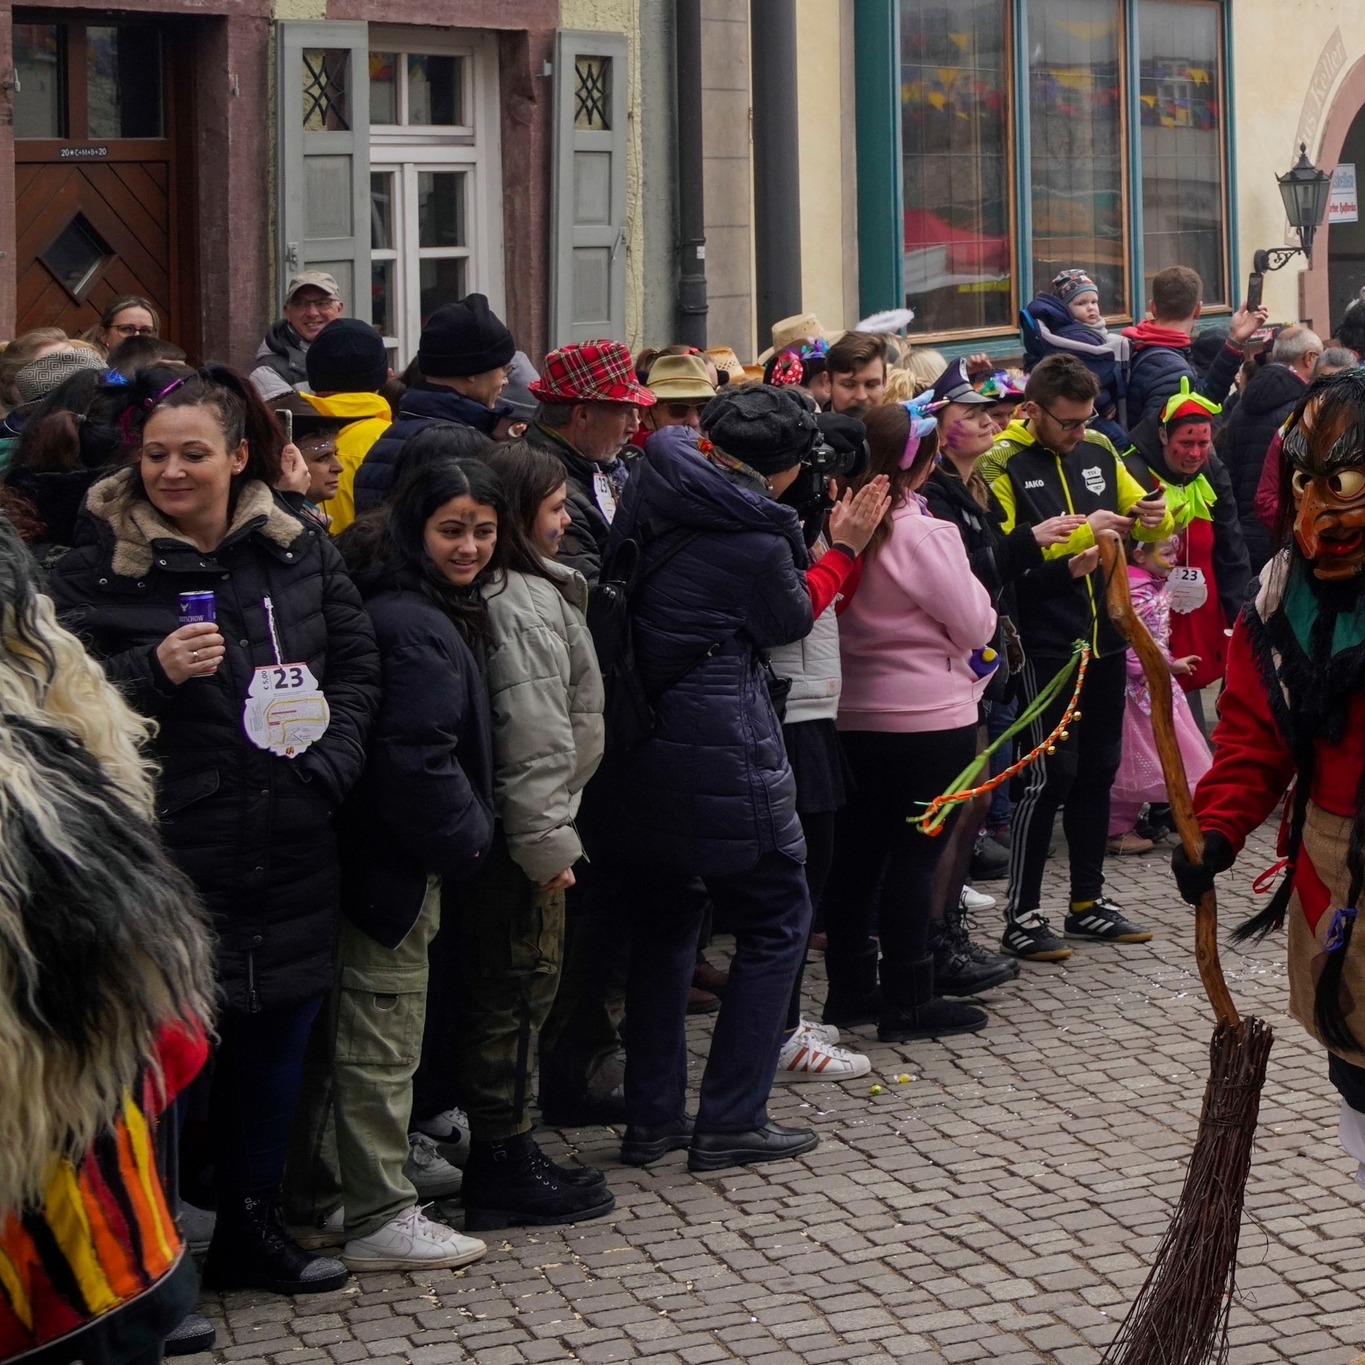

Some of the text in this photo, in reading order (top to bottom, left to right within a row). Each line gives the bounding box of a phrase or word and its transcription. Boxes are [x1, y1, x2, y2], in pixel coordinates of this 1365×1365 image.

[1025, 479, 1044, 489] JAKO
[1181, 569, 1198, 581] 23
[261, 670, 269, 685] 5,00
[273, 667, 304, 690] 23
